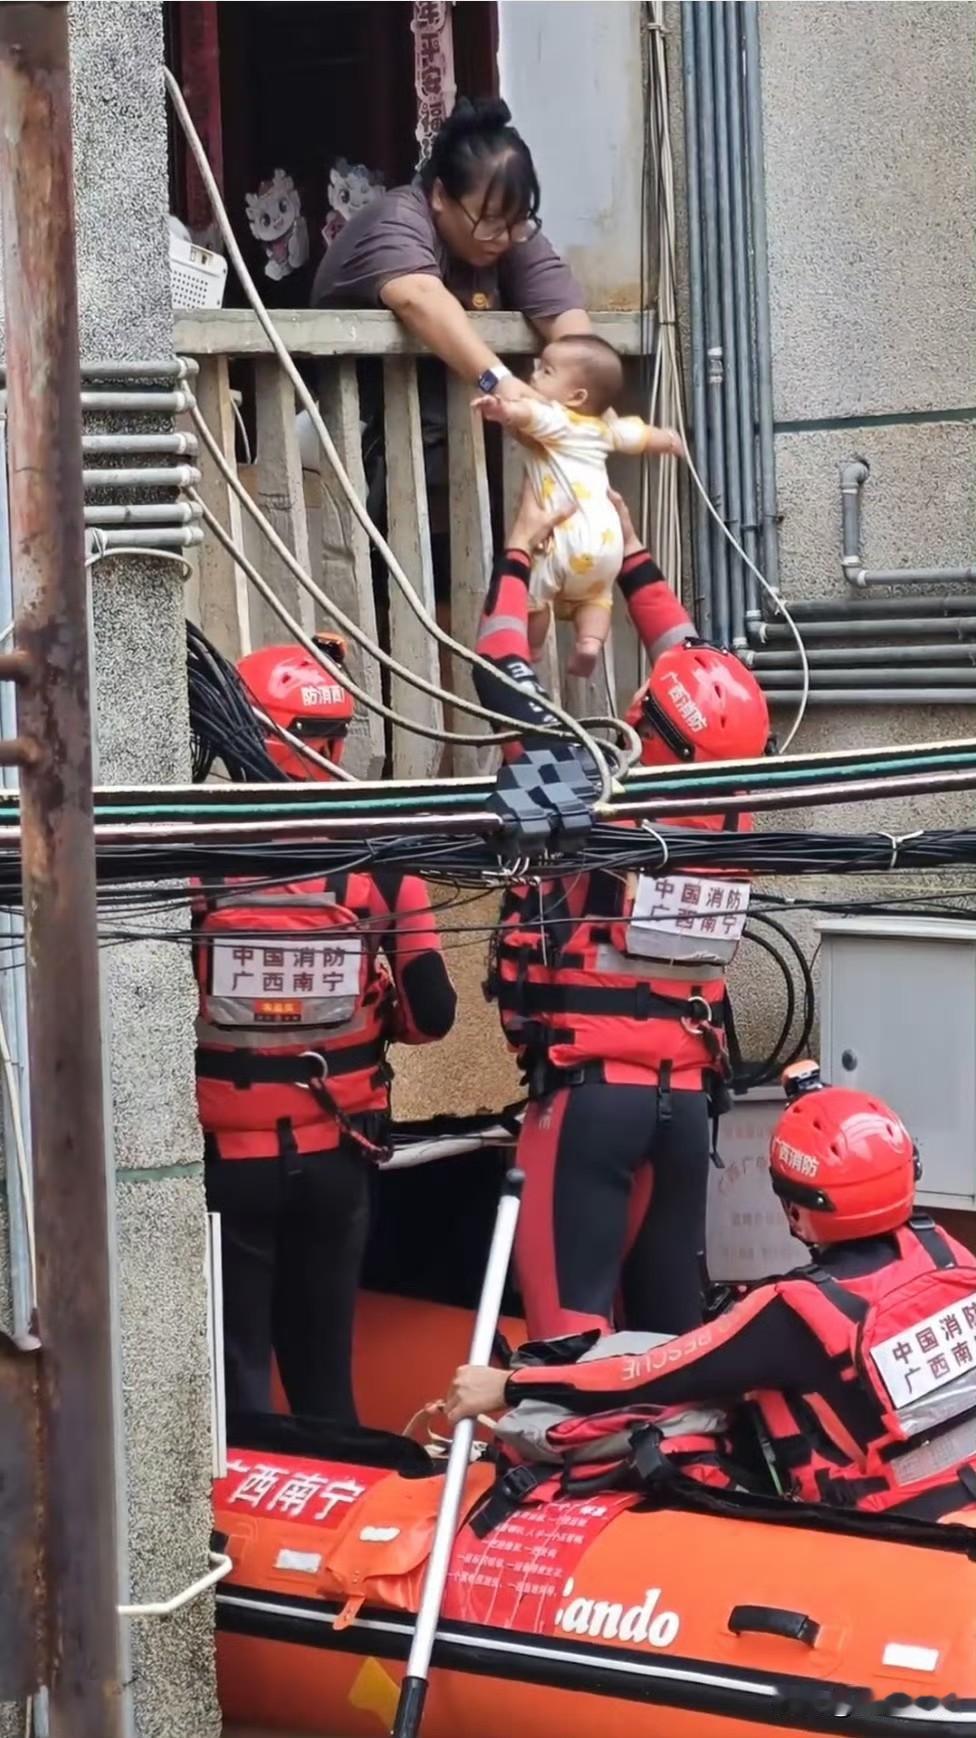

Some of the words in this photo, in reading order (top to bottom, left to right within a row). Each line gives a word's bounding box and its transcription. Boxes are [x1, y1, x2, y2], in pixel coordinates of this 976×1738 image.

[659, 671, 709, 733] 广西消防
[654, 879, 743, 910] 中国消防
[649, 904, 739, 934] 广西南宁
[232, 946, 345, 968] 中国消防
[231, 971, 345, 993] 广西南宁
[771, 1136, 820, 1178] 广西消防
[903, 1340, 976, 1395] 广西南
